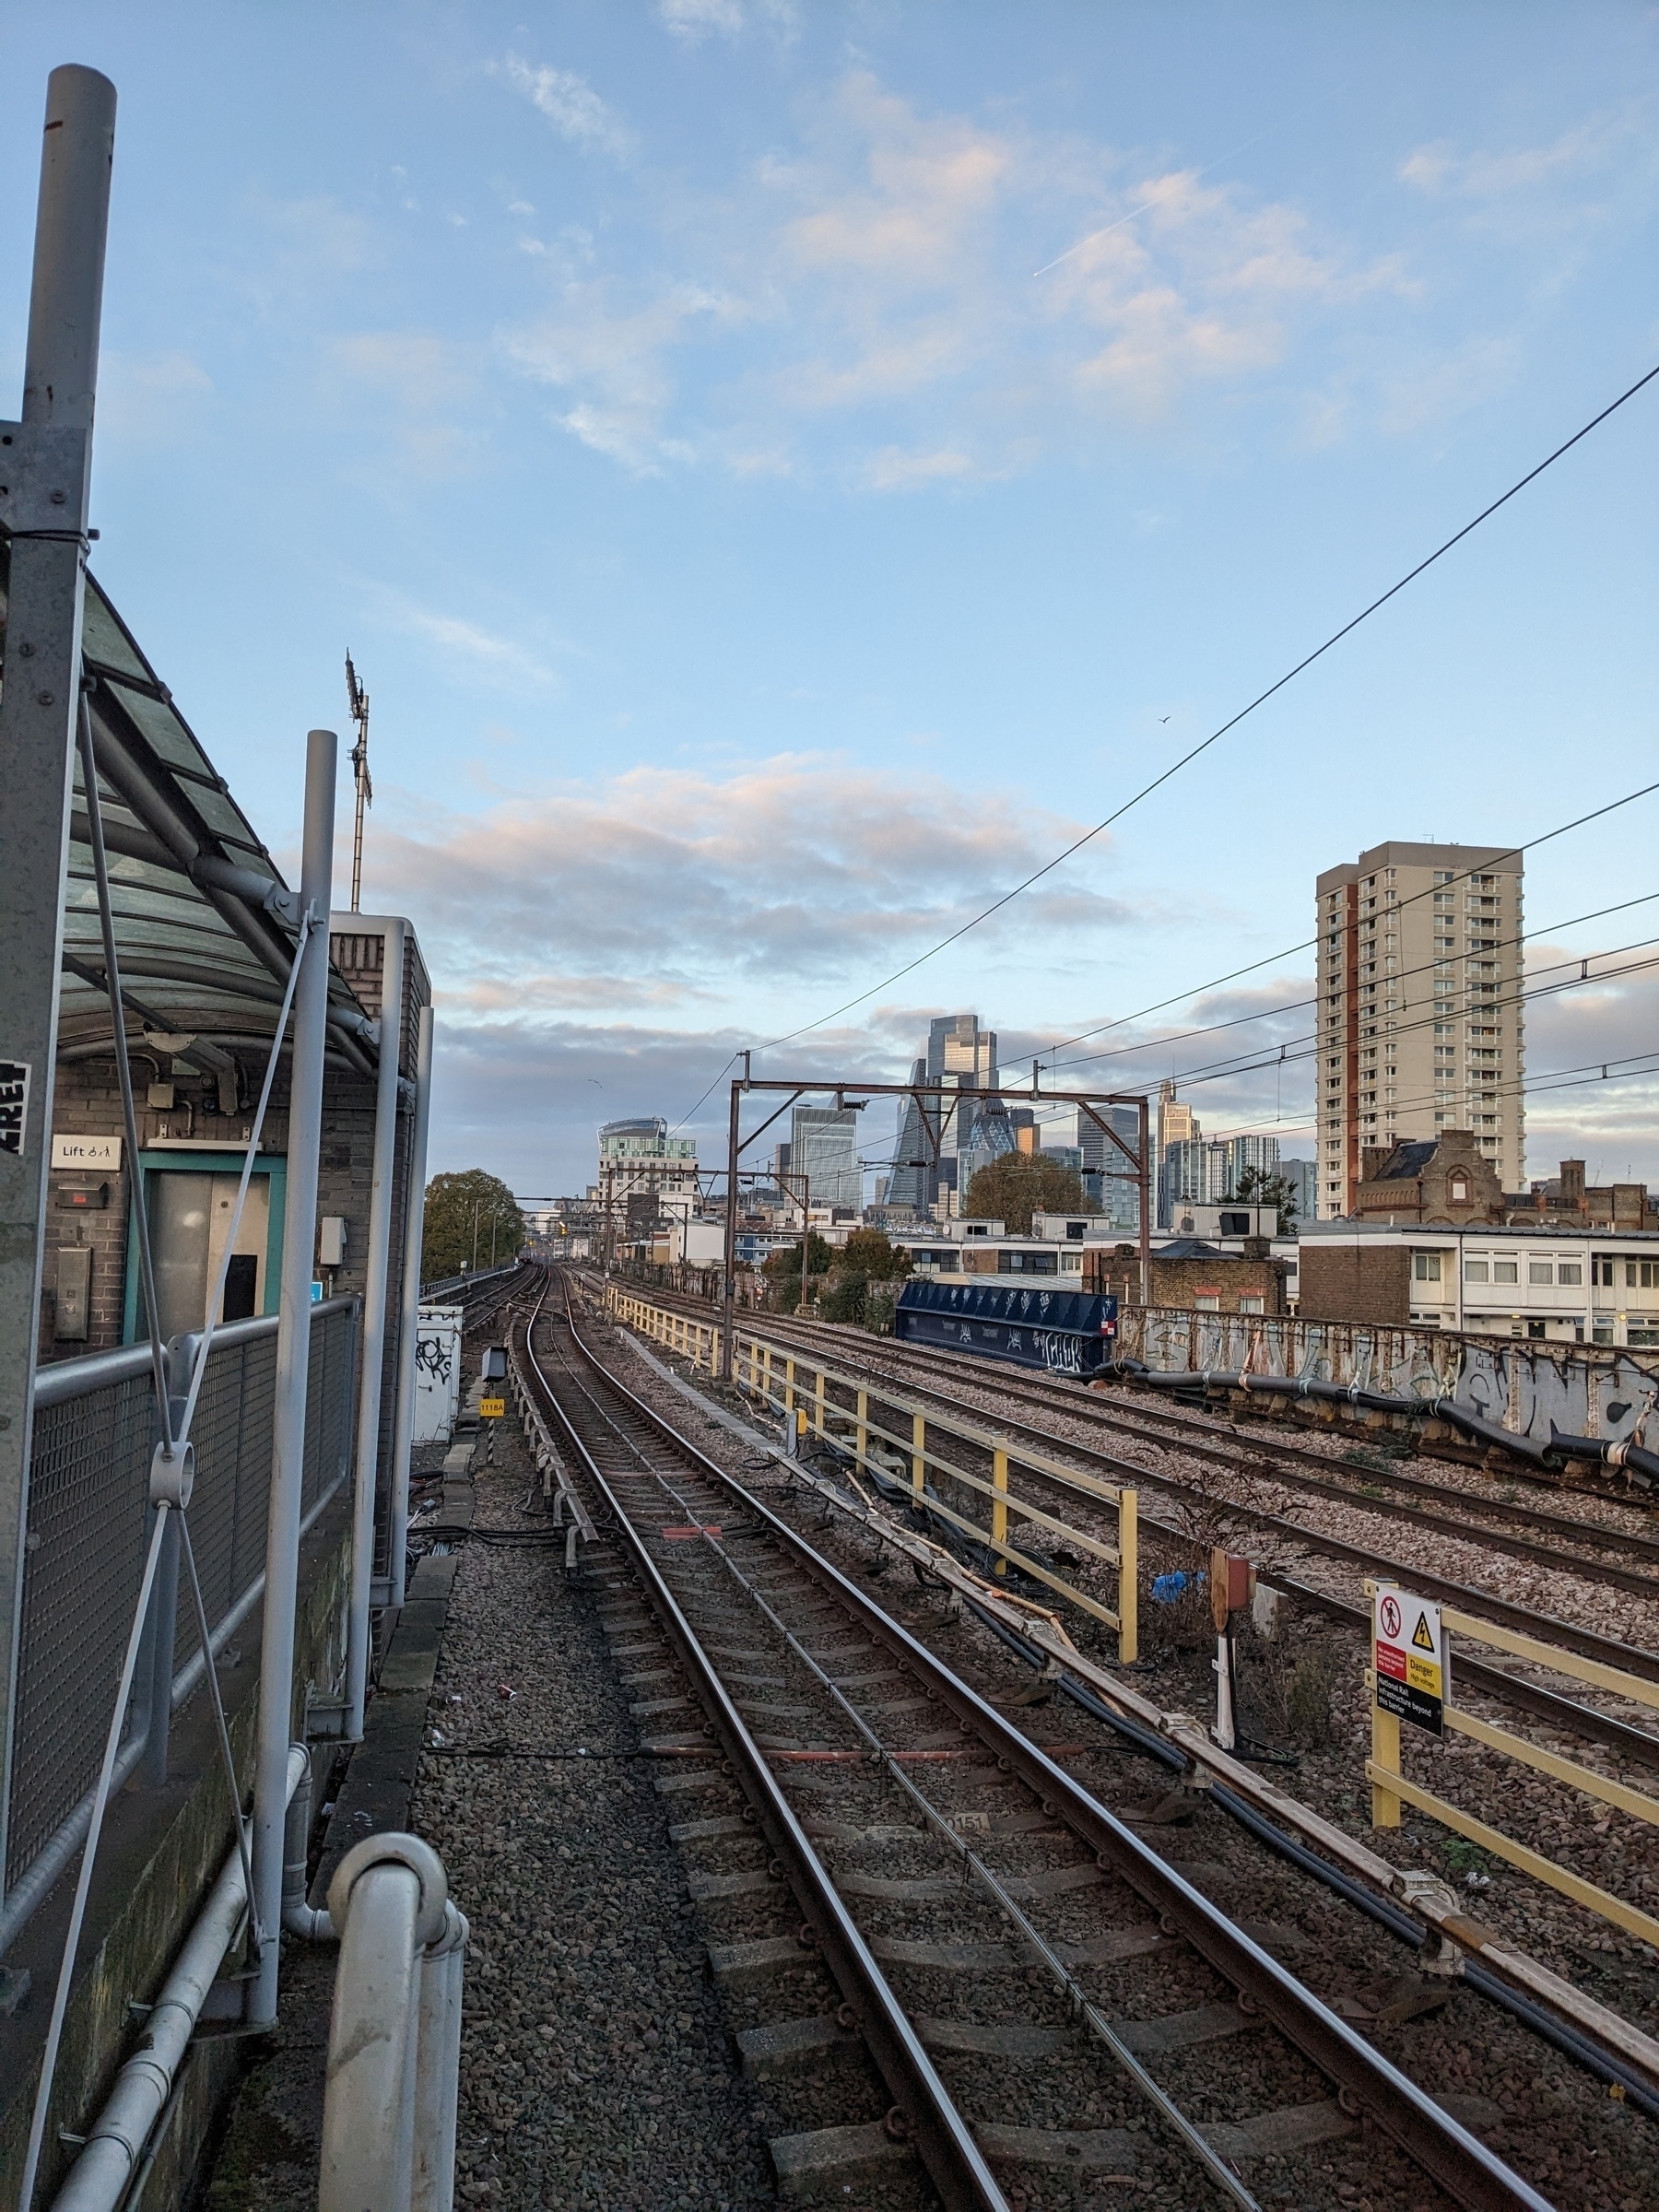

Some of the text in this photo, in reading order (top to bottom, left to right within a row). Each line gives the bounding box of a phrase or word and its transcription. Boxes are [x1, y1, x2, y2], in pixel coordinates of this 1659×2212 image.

[63, 1146, 85, 1157] Lift
[1410, 1659, 1433, 1677] Danger
[1378, 1677, 1409, 1697] National Rail
[1410, 1673, 1435, 1689] High voltage
[1378, 1696, 1406, 1714] this barrier
[1412, 1701, 1432, 1717] beyond
